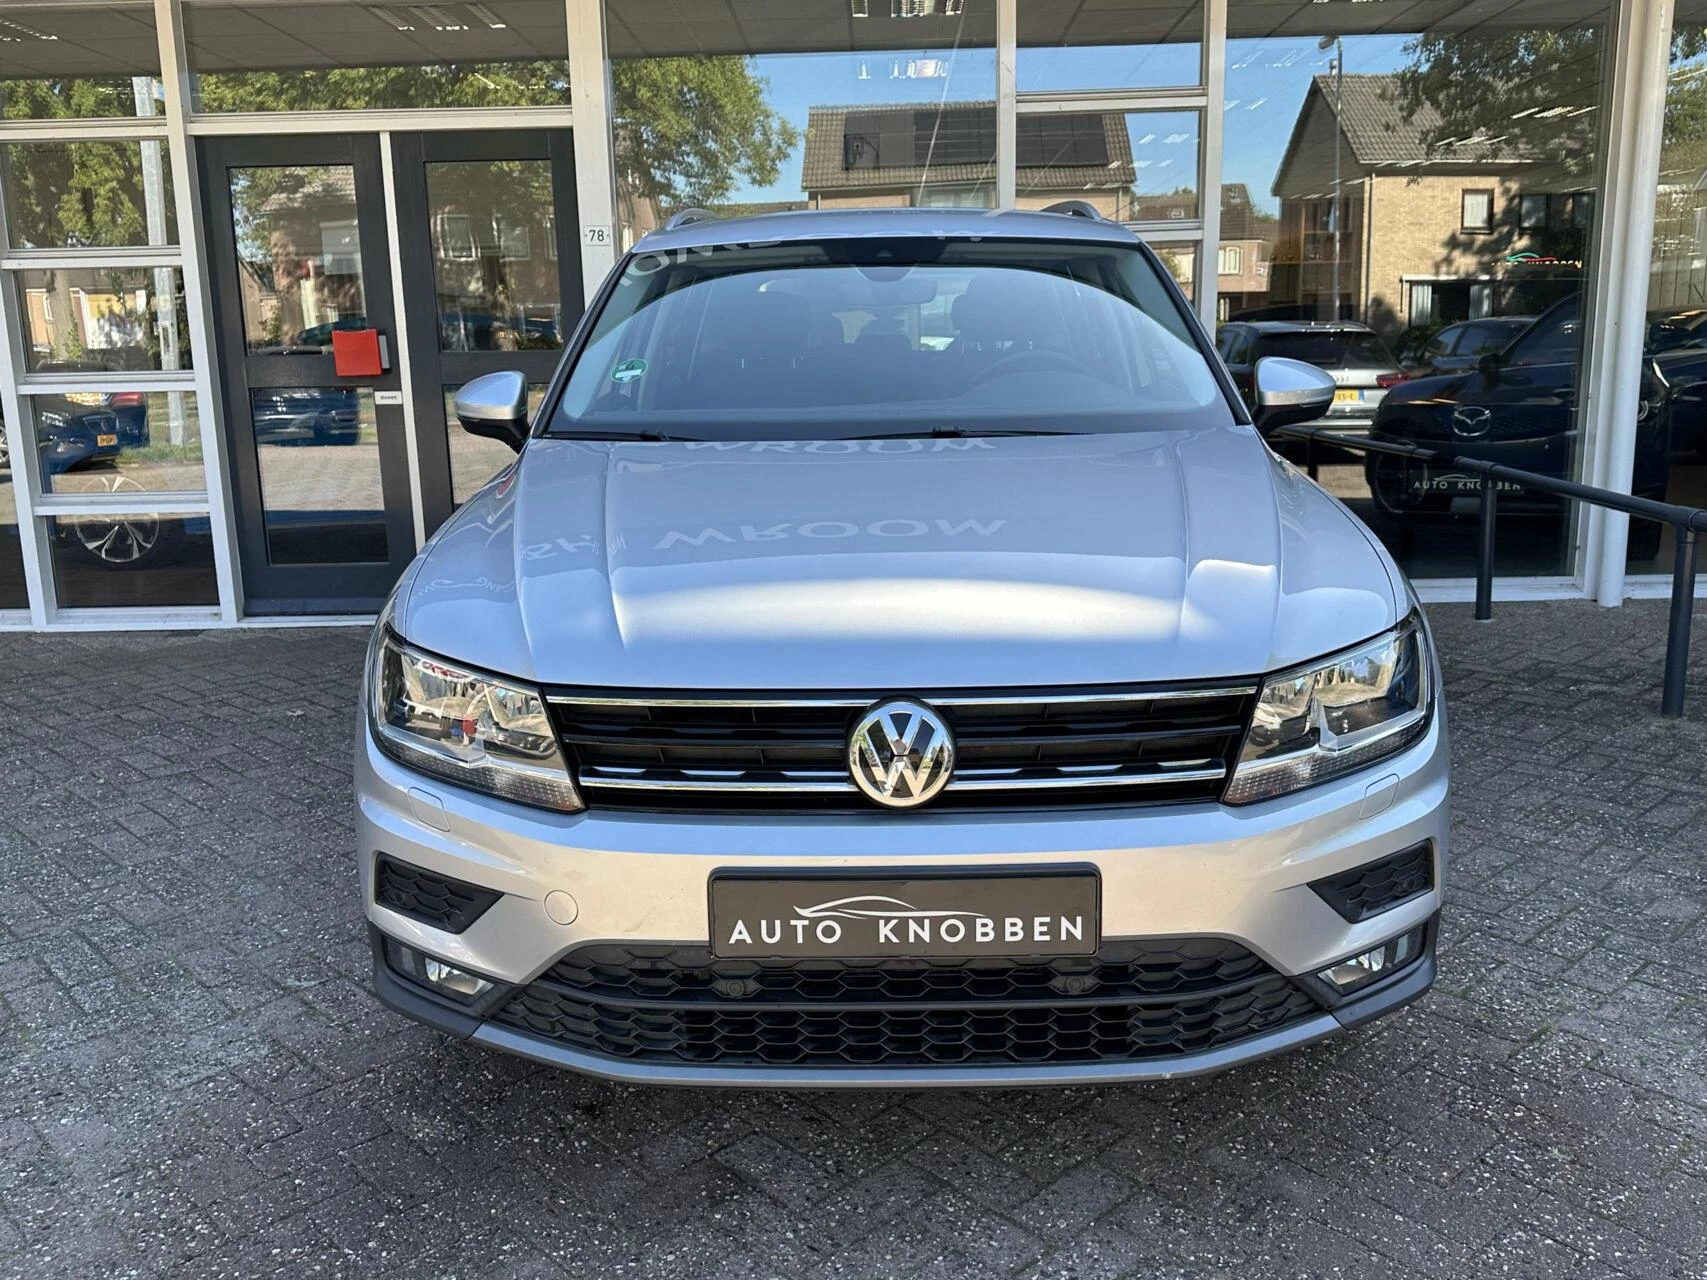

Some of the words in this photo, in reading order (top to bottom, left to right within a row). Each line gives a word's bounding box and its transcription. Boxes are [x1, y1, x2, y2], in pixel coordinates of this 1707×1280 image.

[589, 229, 605, 242] 78
[1413, 481, 1448, 489] AUTO
[728, 919, 842, 945] AUTO
[878, 915, 1083, 944] KNOBBEN
